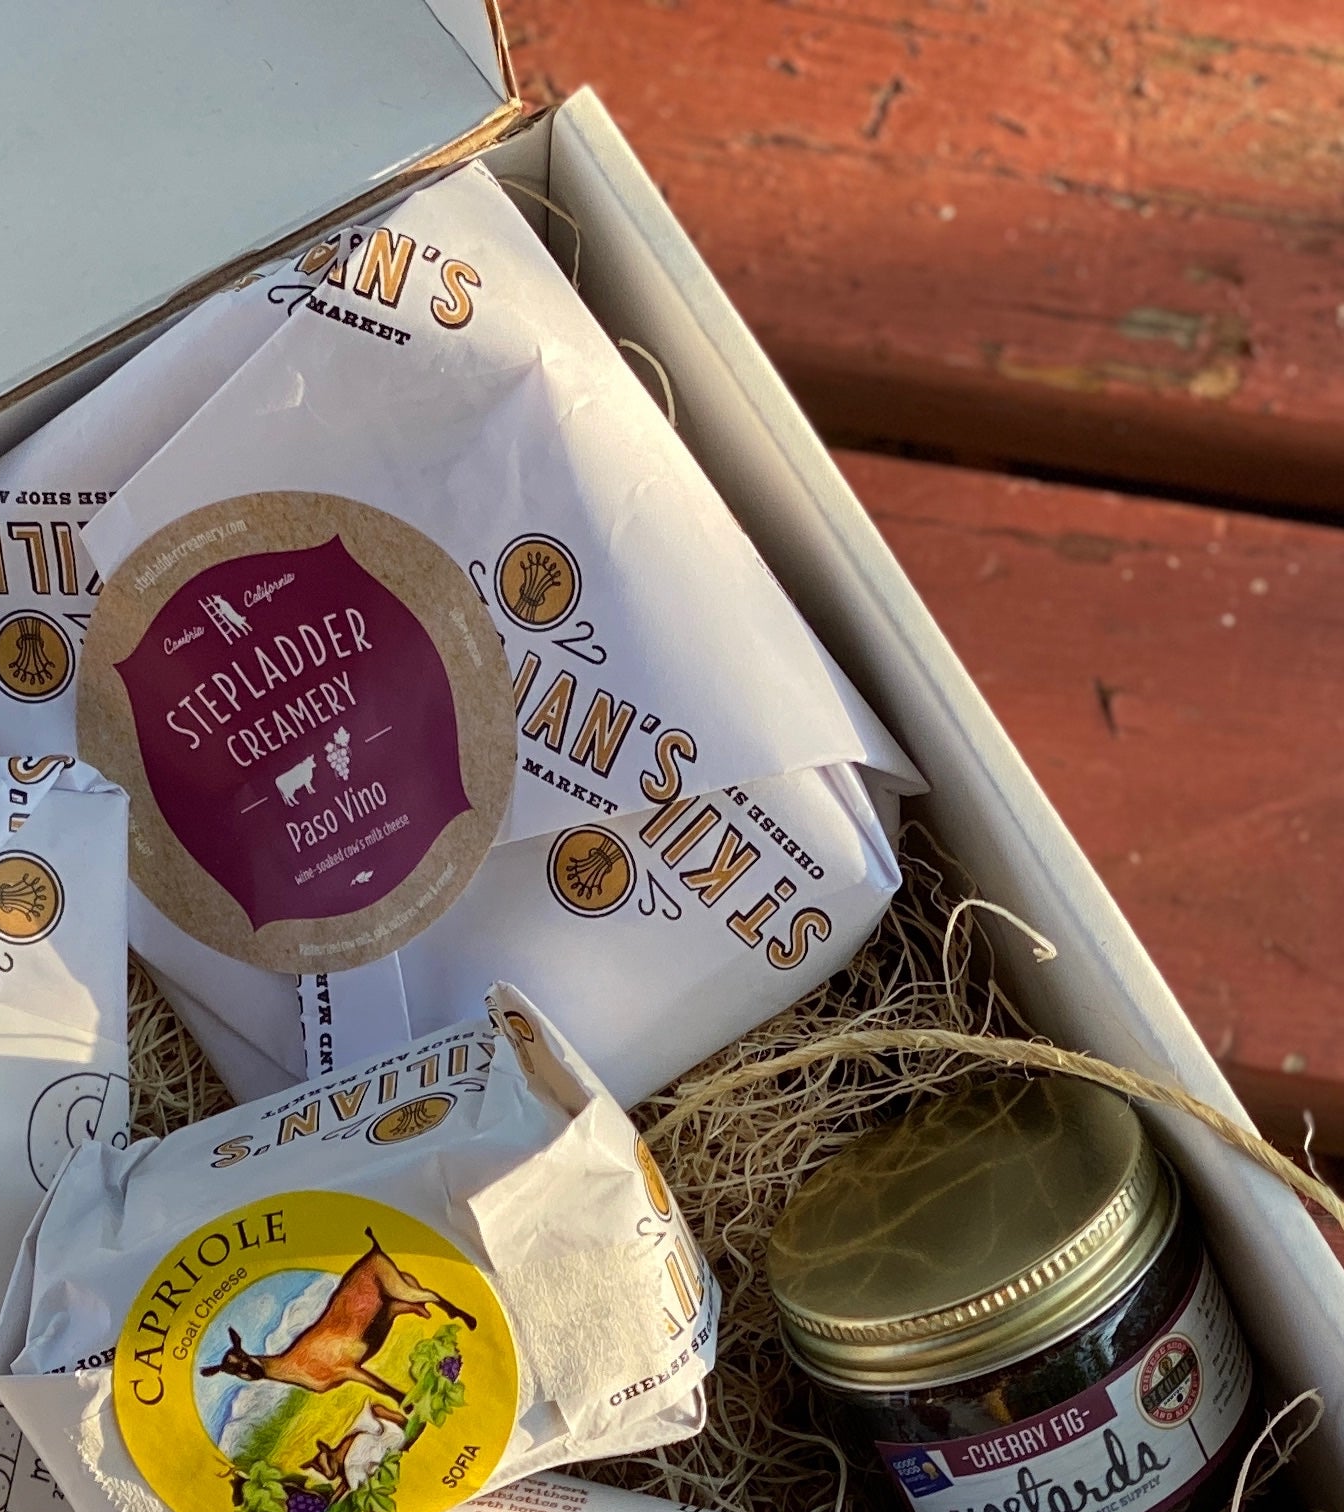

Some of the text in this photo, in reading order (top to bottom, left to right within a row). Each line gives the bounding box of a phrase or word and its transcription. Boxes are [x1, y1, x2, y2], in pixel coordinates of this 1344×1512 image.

[306, 296, 411, 346] MARKET
[16, 491, 71, 505] SHOP
[243, 573, 295, 608] California
[167, 608, 373, 750] STEPLADDER
[227, 671, 356, 767] CREAMERY
[522, 757, 618, 816] MARKET
[286, 781, 387, 853] Paso Vino
[383, 814, 410, 838] cheese
[747, 805, 825, 882] CHEESE
[133, 1209, 288, 1407] CAPRIOLE
[173, 1266, 248, 1361] Goat Cheese
[441, 1444, 481, 1490] SOFIA
[1121, 1475, 1161, 1507] SUPPLY
